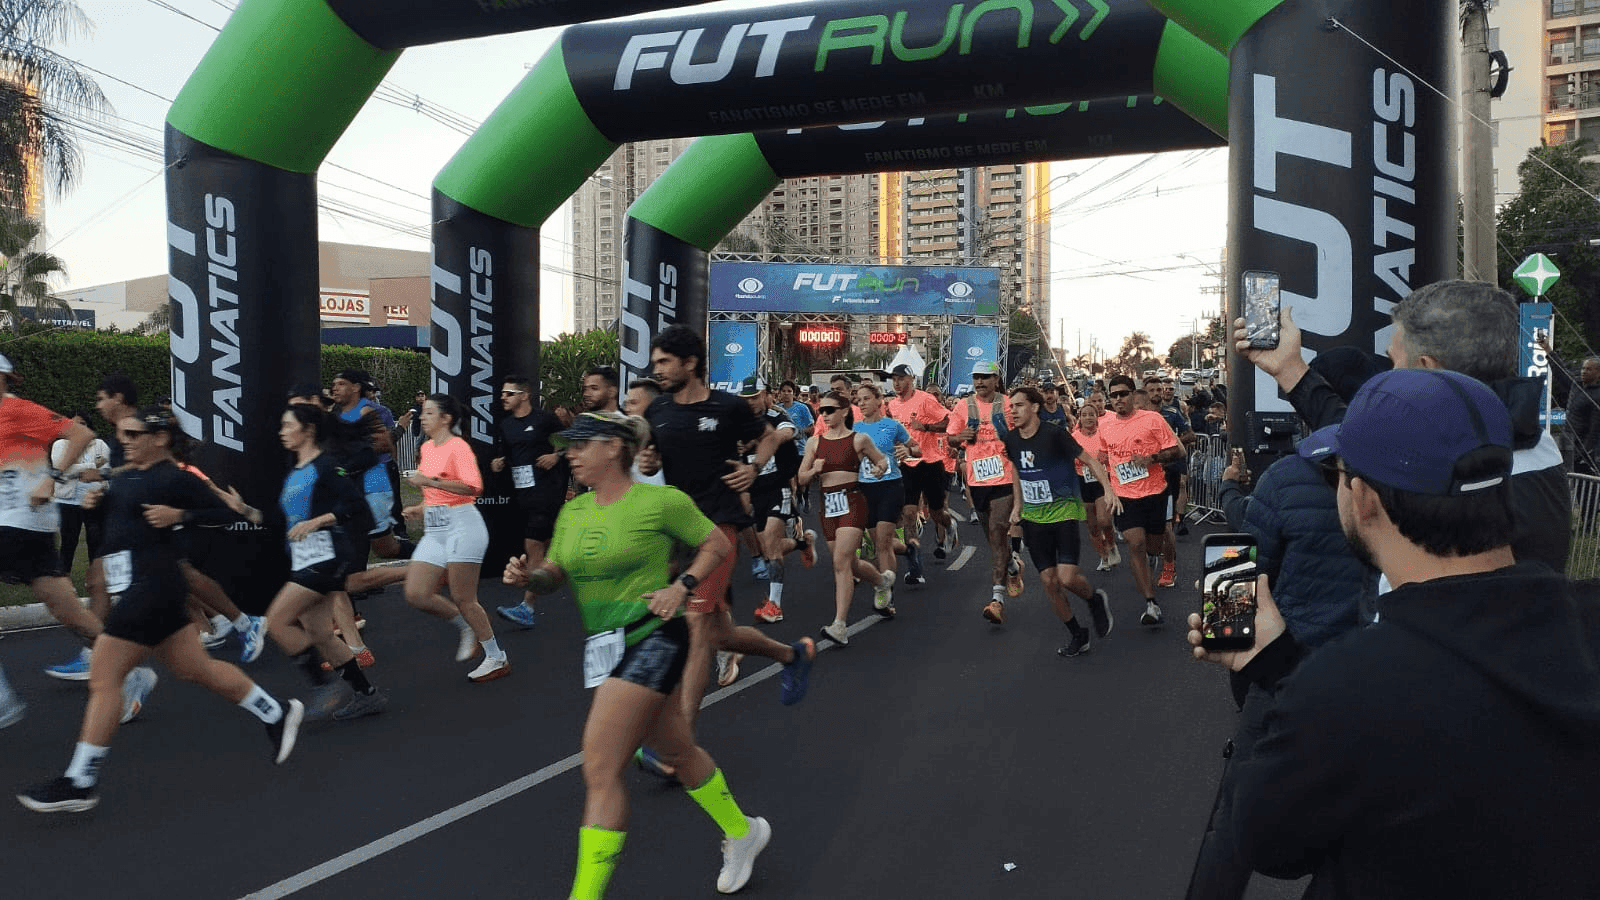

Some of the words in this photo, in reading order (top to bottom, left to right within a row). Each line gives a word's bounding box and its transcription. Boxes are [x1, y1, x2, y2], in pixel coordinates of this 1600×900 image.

[613, 15, 815, 91] FUT
[320, 298, 364, 312] LOJAS
[793, 273, 858, 291] FUT
[205, 193, 244, 452] FANATICS
[470, 246, 494, 445] FANATICS
[977, 456, 1001, 479] 5900
